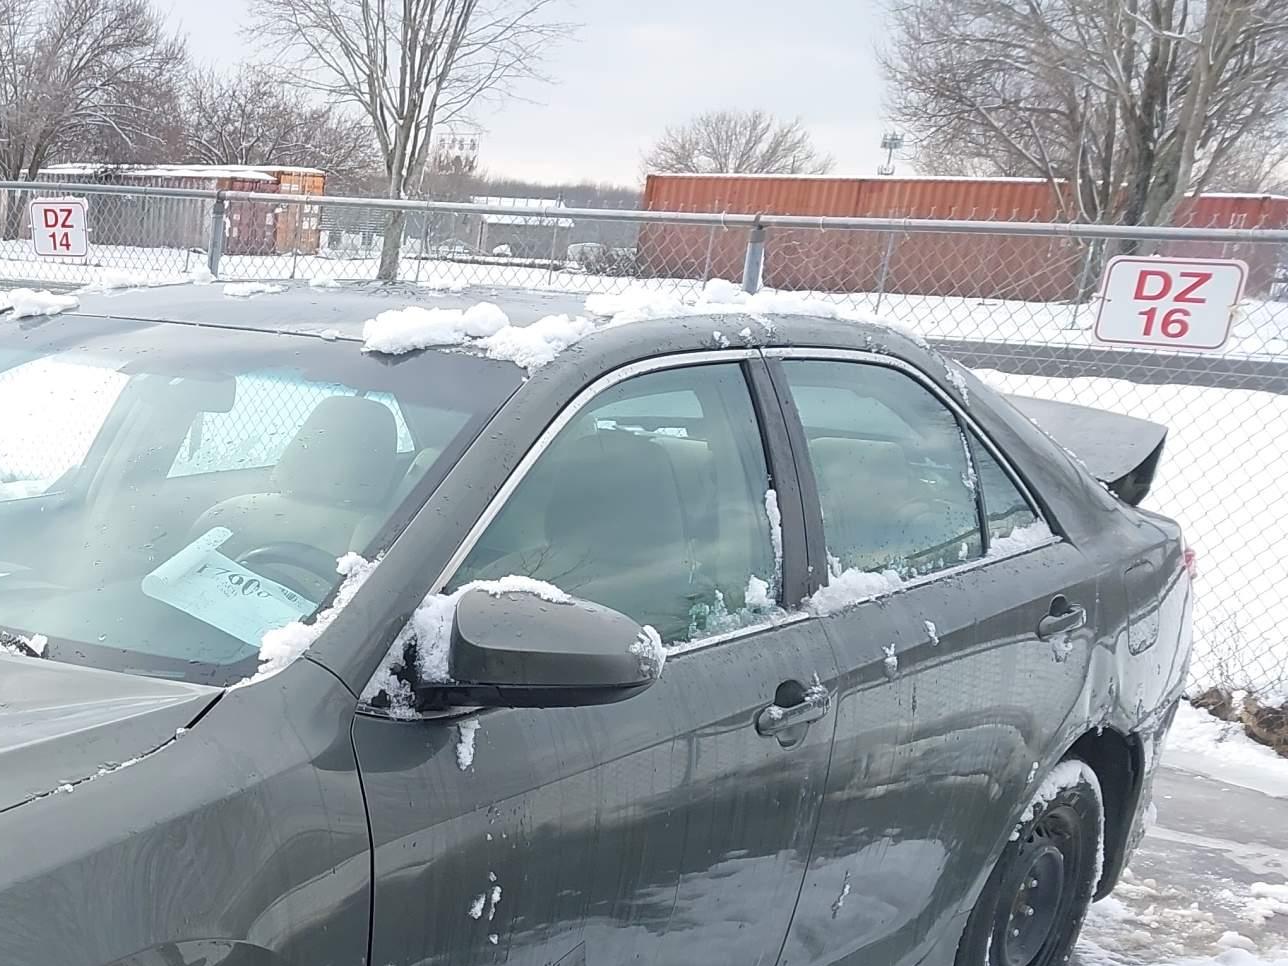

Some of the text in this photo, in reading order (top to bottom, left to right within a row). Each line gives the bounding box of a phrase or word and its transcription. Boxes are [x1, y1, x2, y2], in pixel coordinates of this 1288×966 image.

[43, 208, 74, 228] DZ
[48, 232, 72, 251] 14
[1133, 270, 1213, 303] DZ
[1138, 307, 1192, 338] 16
